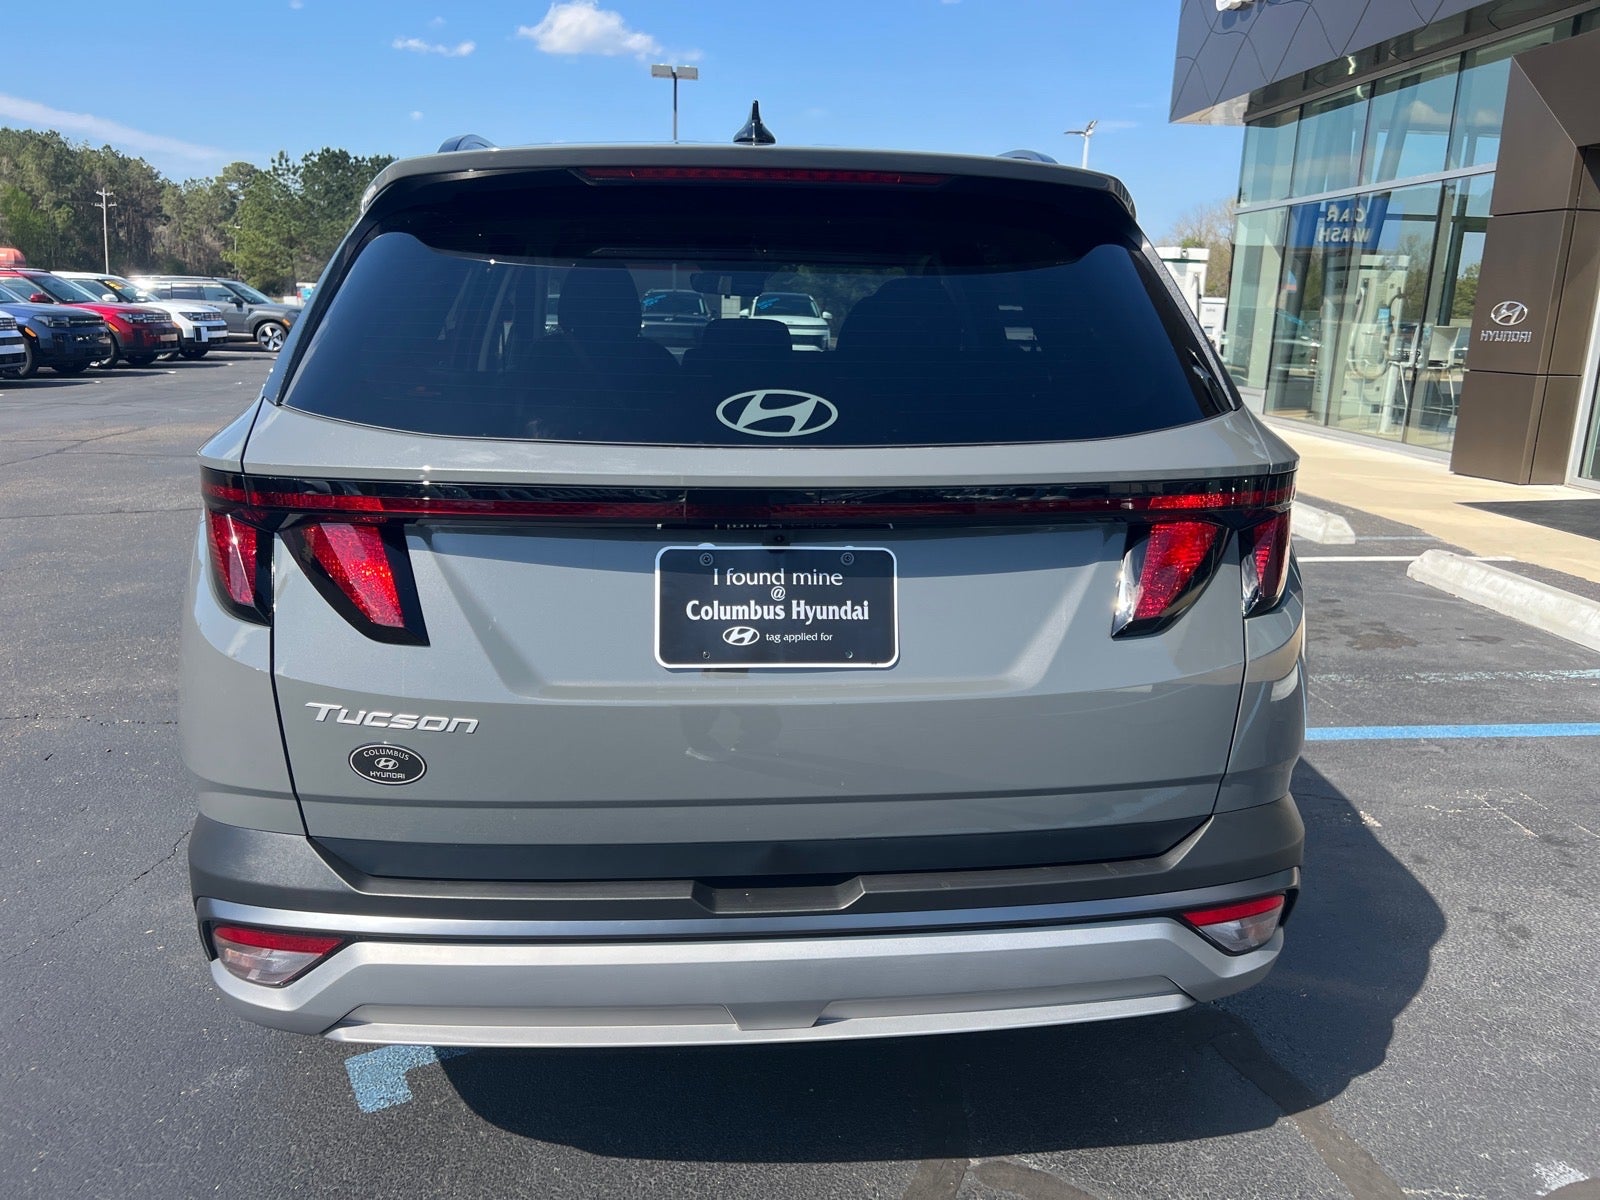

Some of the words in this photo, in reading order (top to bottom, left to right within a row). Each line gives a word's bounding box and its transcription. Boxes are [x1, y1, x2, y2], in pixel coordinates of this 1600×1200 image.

[1480, 330, 1532, 343] HYUNDAI
[713, 568, 719, 586] I
[726, 568, 785, 586] found
[792, 568, 843, 586] mine
[770, 586, 786, 601] @
[686, 600, 786, 621] Columbus
[792, 600, 869, 625] Hyundai
[766, 633, 781, 643] tag
[783, 632, 818, 643] applied
[820, 632, 833, 641] for
[363, 748, 410, 761] COLUMBUS
[370, 770, 406, 779] HYUNDAI
